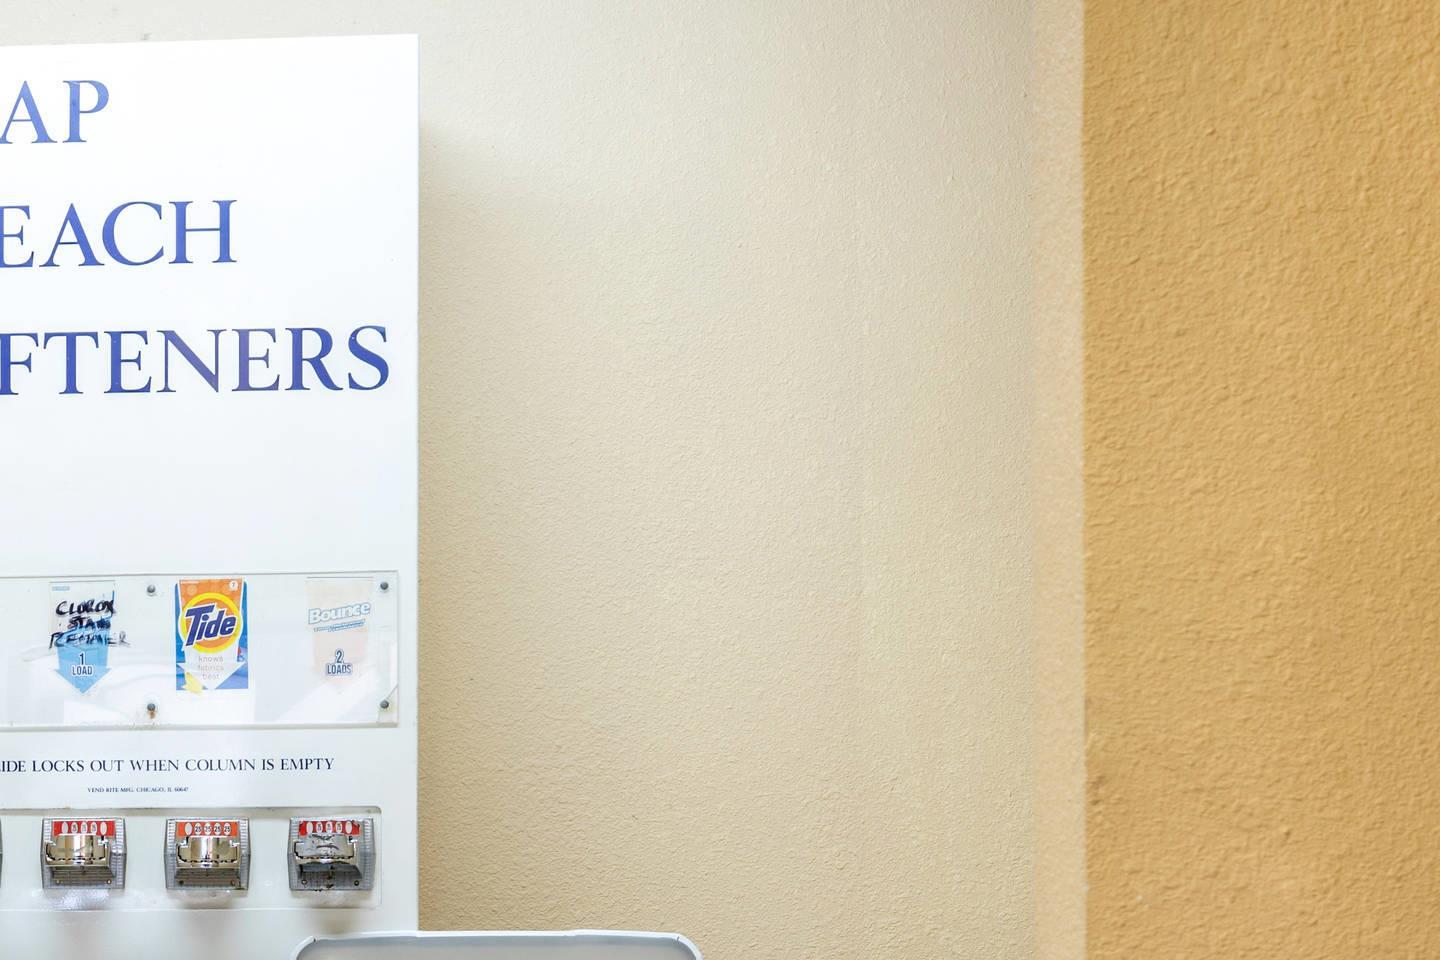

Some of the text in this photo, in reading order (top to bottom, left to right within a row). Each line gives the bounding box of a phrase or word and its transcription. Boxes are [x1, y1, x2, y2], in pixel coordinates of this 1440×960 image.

[308, 602, 371, 625] Bounce
[185, 605, 237, 647] Tide
[79, 653, 85, 665] 1
[335, 649, 344, 664] 2
[72, 665, 93, 676] LOAD
[202, 672, 220, 680] best
[327, 664, 353, 675] LOADS
[32, 760, 84, 772] LOCKS
[90, 760, 124, 772] OUT
[130, 760, 179, 771] WHEN
[185, 759, 255, 771] COLUMN
[262, 758, 274, 771] IS
[280, 758, 334, 770] EMPTY
